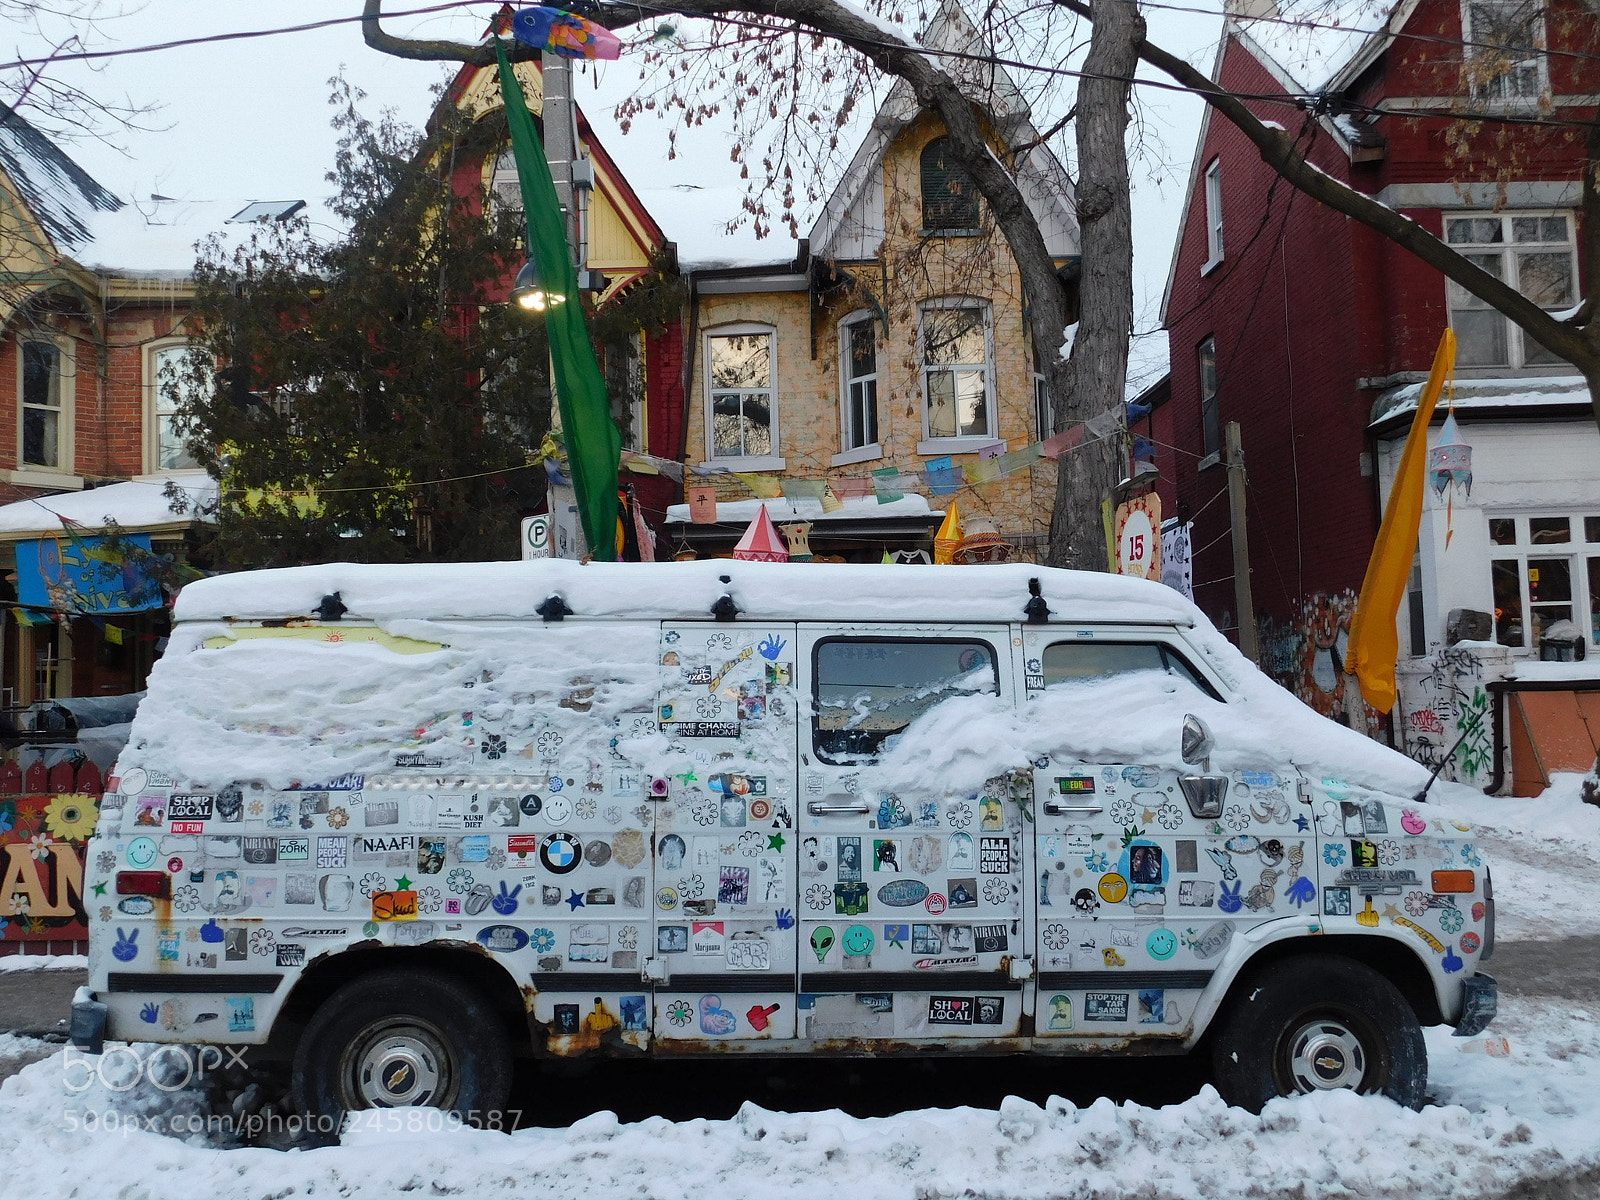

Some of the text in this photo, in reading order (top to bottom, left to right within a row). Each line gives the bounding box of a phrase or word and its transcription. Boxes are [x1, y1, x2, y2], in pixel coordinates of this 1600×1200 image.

[535, 526, 545, 542] P
[1129, 535, 1144, 561] 15
[533, 549, 549, 559] HOUR
[169, 806, 212, 816] LOCAL
[172, 823, 202, 832] NO FUN
[317, 837, 346, 848] MEAN
[542, 833, 580, 847] BMW
[840, 837, 860, 845] WAR
[981, 839, 1008, 850] ALL
[279, 845, 308, 854] ZORK
[317, 848, 346, 858] PEOPLE
[981, 850, 1008, 861] PEOPLE
[317, 857, 346, 868] SUCK
[981, 861, 1009, 873] SUCK
[491, 928, 516, 938] GOT
[974, 925, 1006, 938] NIRVANA
[487, 938, 518, 948] BEER?
[694, 943, 721, 953] Marijuana
[929, 1010, 972, 1021] LOCAL
